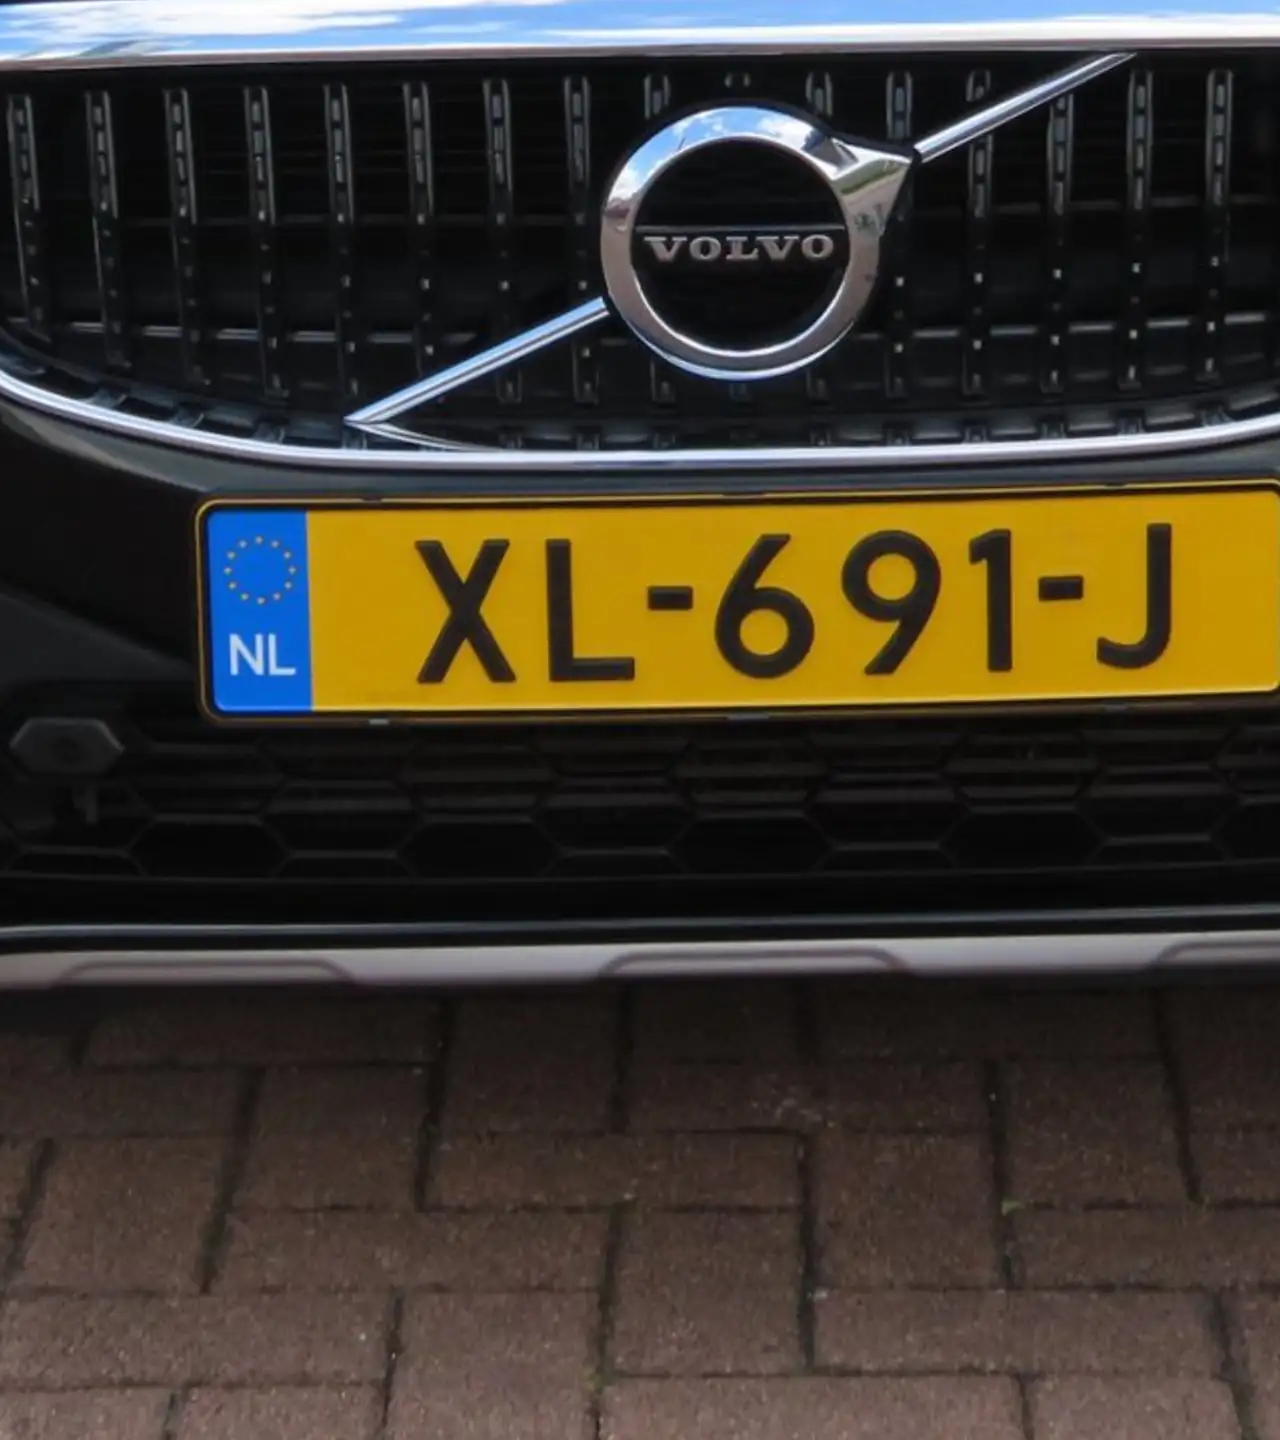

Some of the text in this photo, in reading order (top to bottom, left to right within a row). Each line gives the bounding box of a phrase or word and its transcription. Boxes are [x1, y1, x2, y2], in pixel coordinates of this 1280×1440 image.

[643, 234, 835, 262] VOLVO
[414, 521, 1173, 684] XL-691-J
[228, 632, 297, 677] NL
